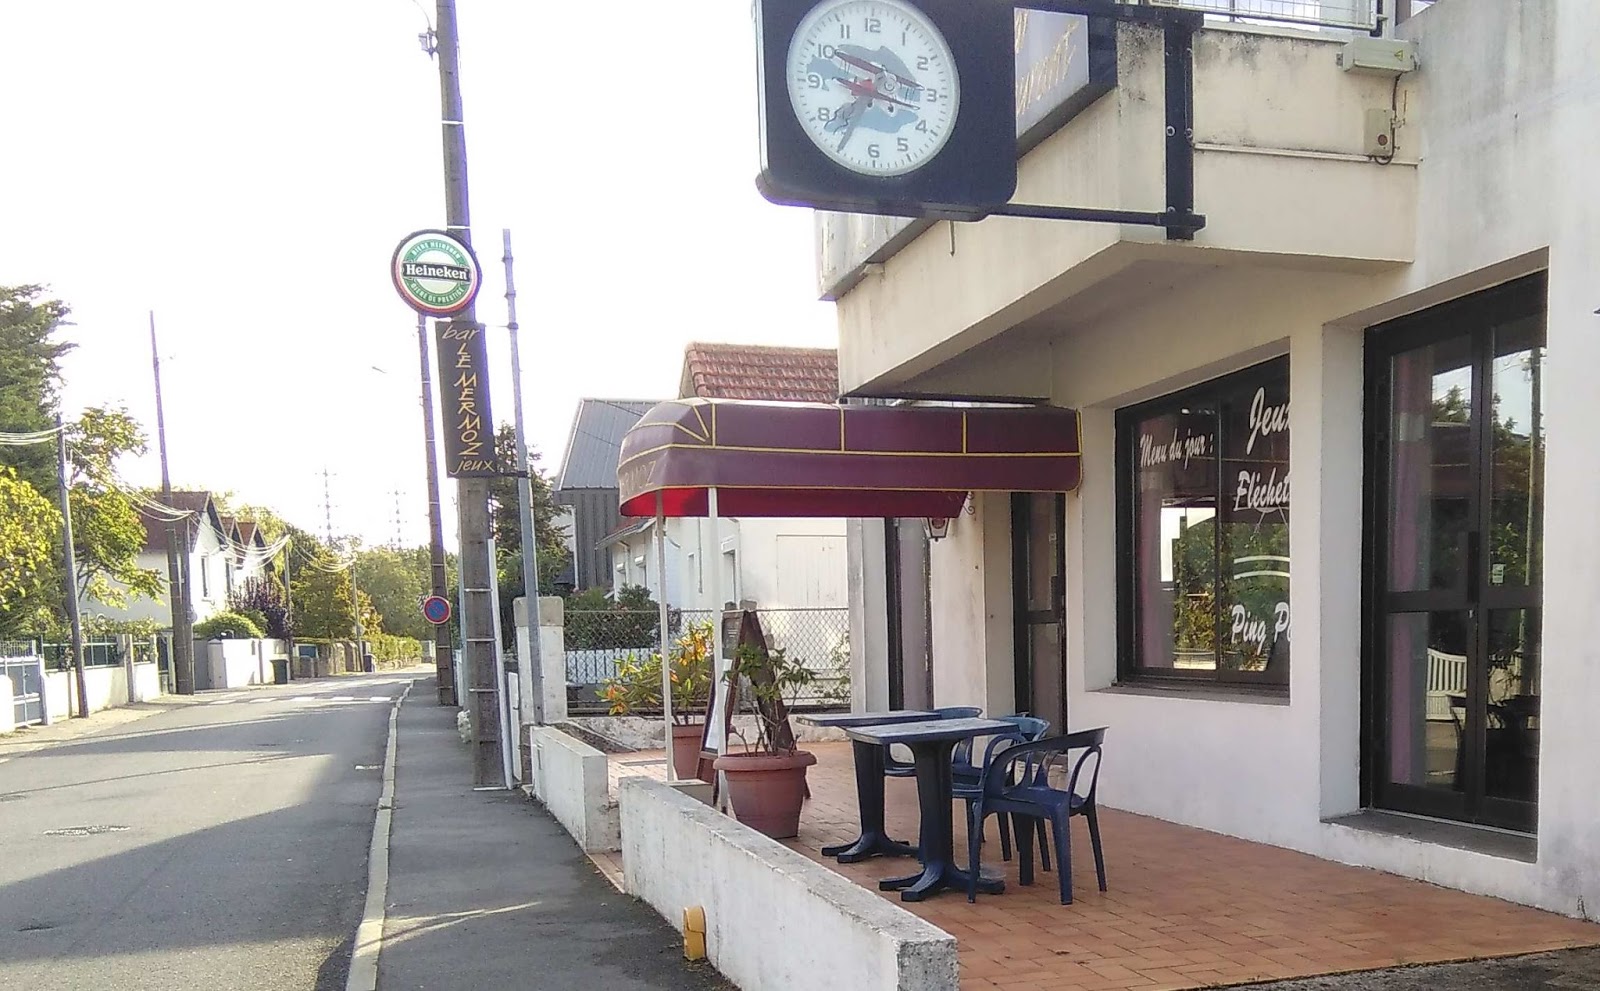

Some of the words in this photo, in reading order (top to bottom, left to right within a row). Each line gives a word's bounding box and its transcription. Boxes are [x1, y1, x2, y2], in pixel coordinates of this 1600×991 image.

[840, 24, 851, 39] 11
[864, 18, 882, 34] 12
[817, 44, 836, 59] 10
[917, 56, 929, 71] 2
[807, 74, 821, 89] 9
[926, 88, 938, 103] 3
[817, 107, 830, 122] 8
[915, 119, 928, 134] 4
[867, 144, 880, 159] 6
[897, 138, 909, 152] 5
[405, 264, 468, 280] Heineken
[442, 324, 480, 340] bar
[455, 343, 471, 368] LE
[453, 371, 483, 456] MERMOZ
[1140, 433, 1168, 468] Menu
[1169, 428, 1183, 461] du
[1184, 428, 1206, 470] jour
[449, 456, 495, 475] jeux
[1231, 604, 1267, 656] Ping
